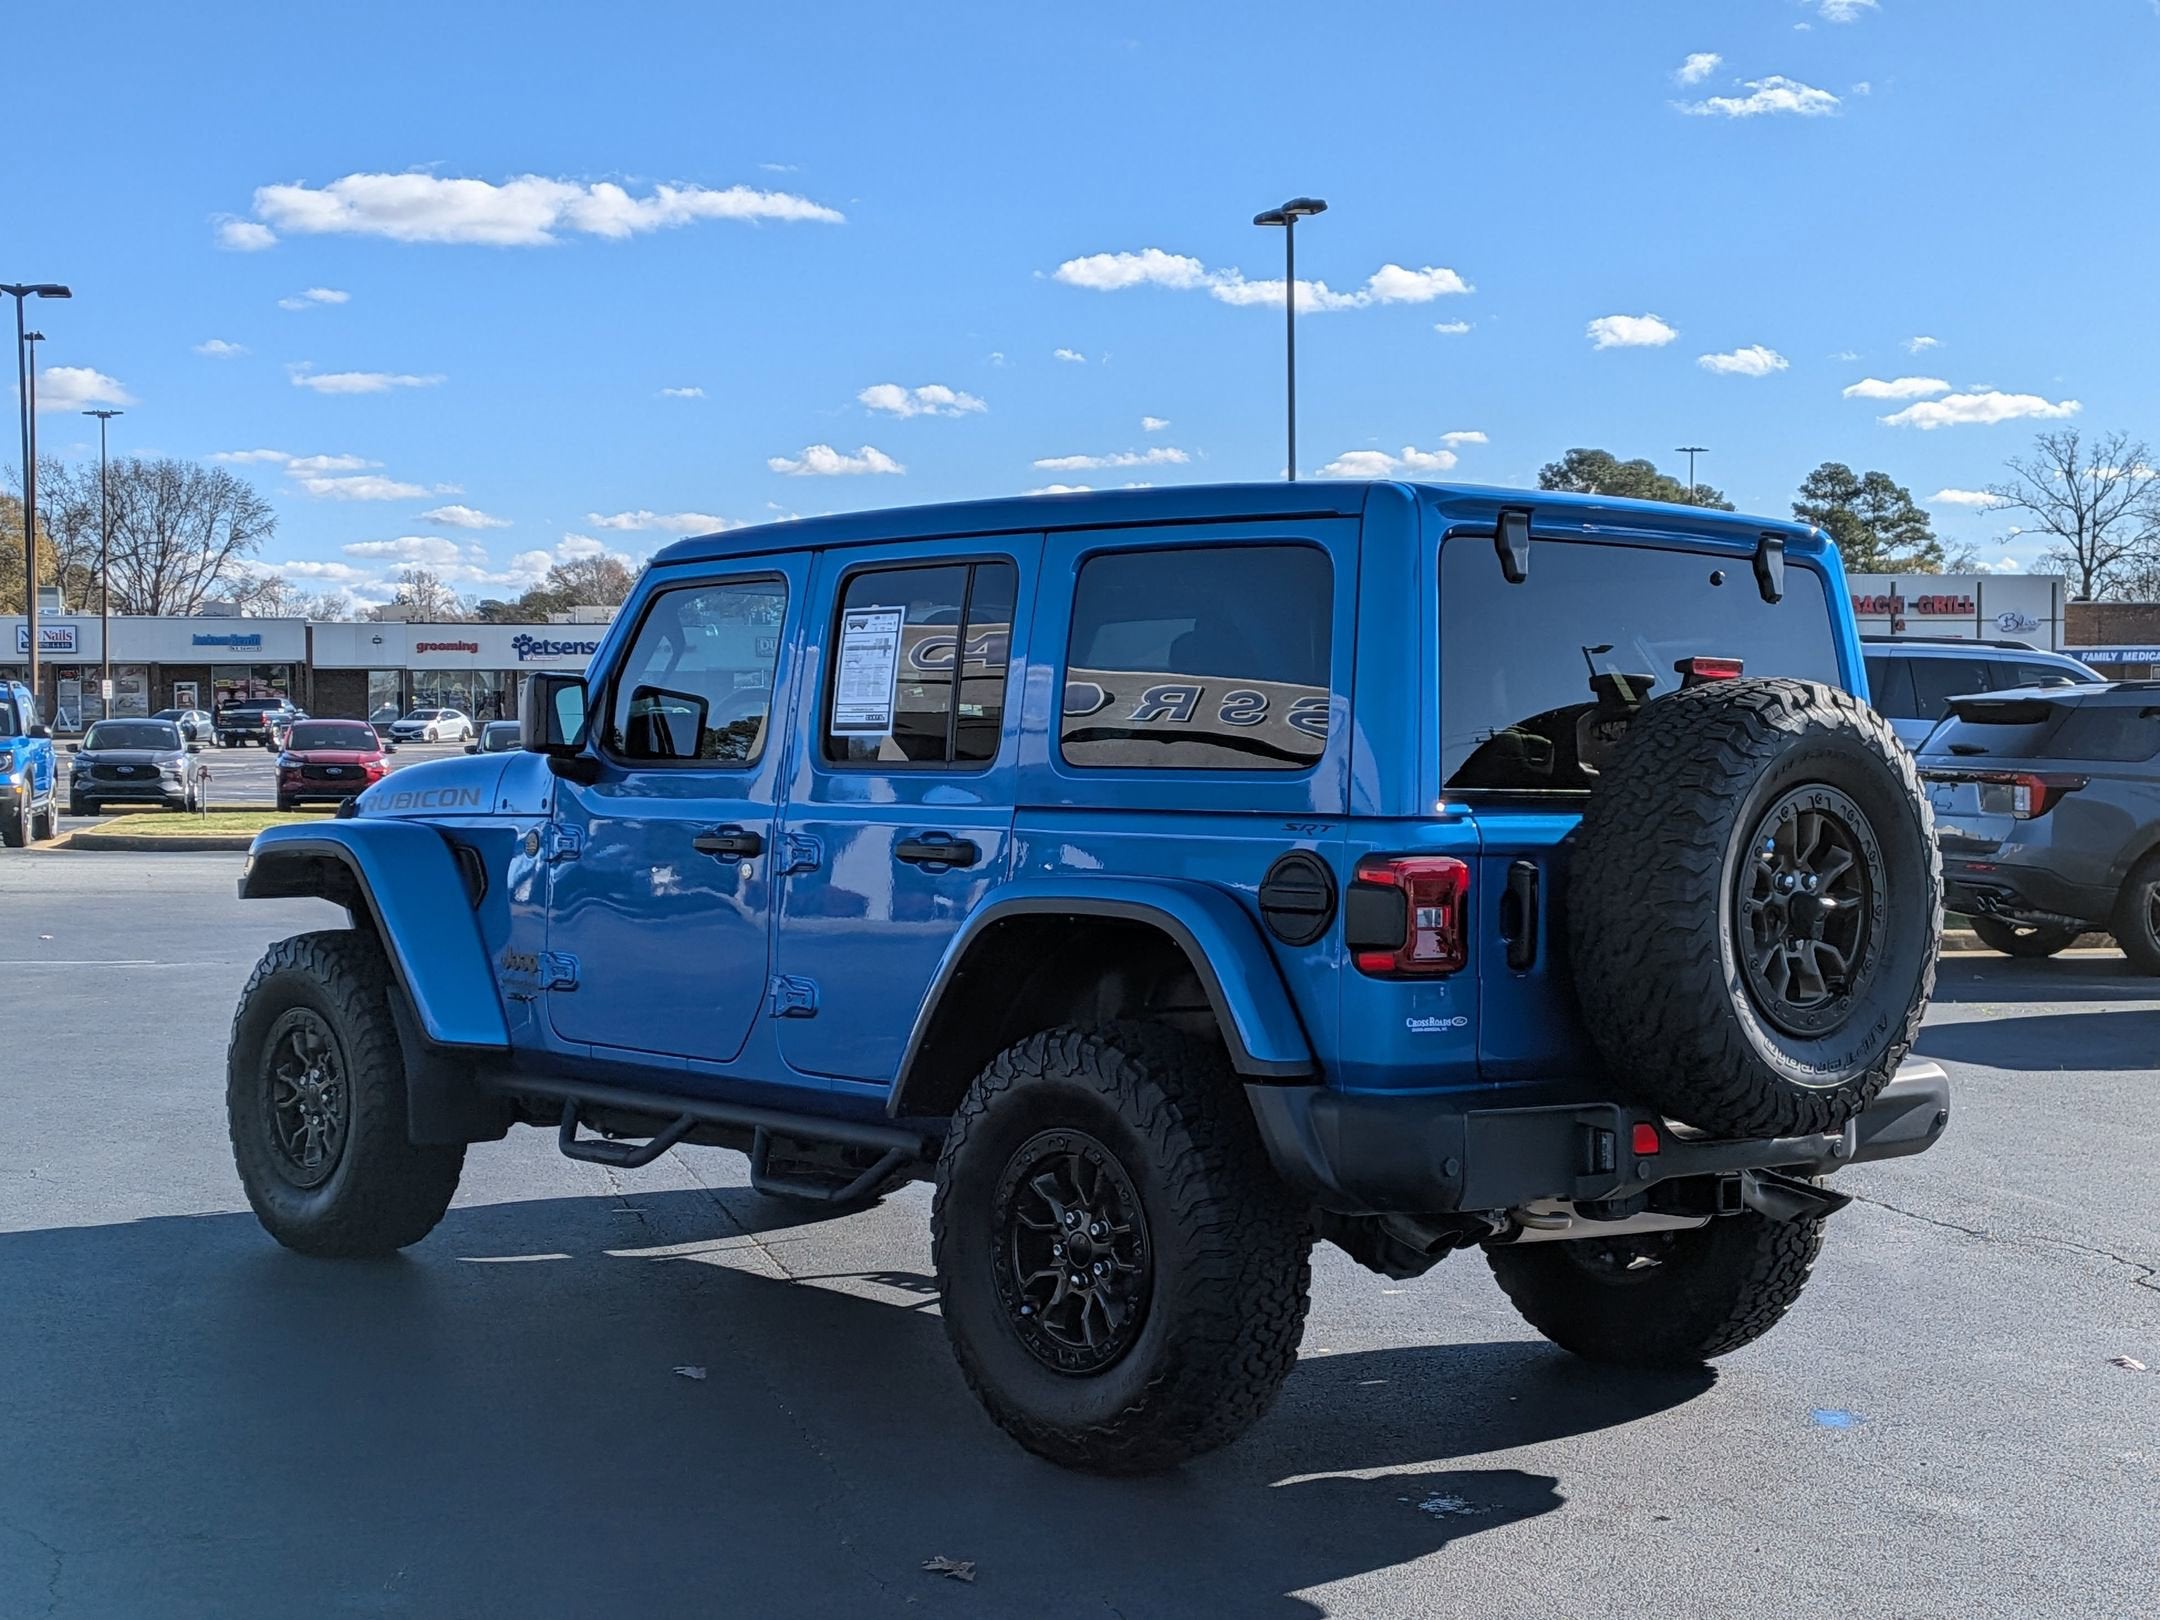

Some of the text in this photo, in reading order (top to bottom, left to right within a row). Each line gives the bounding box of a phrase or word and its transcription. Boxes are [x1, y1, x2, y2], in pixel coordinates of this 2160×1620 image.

[1918, 595, 1975, 615] GRILL
[42, 629, 73, 641] Nails
[416, 640, 479, 654] grooming
[517, 639, 601, 662] petsens
[2081, 652, 2118, 662] FAMILY
[359, 788, 480, 813] RUBICON
[1280, 822, 1337, 836] SRT
